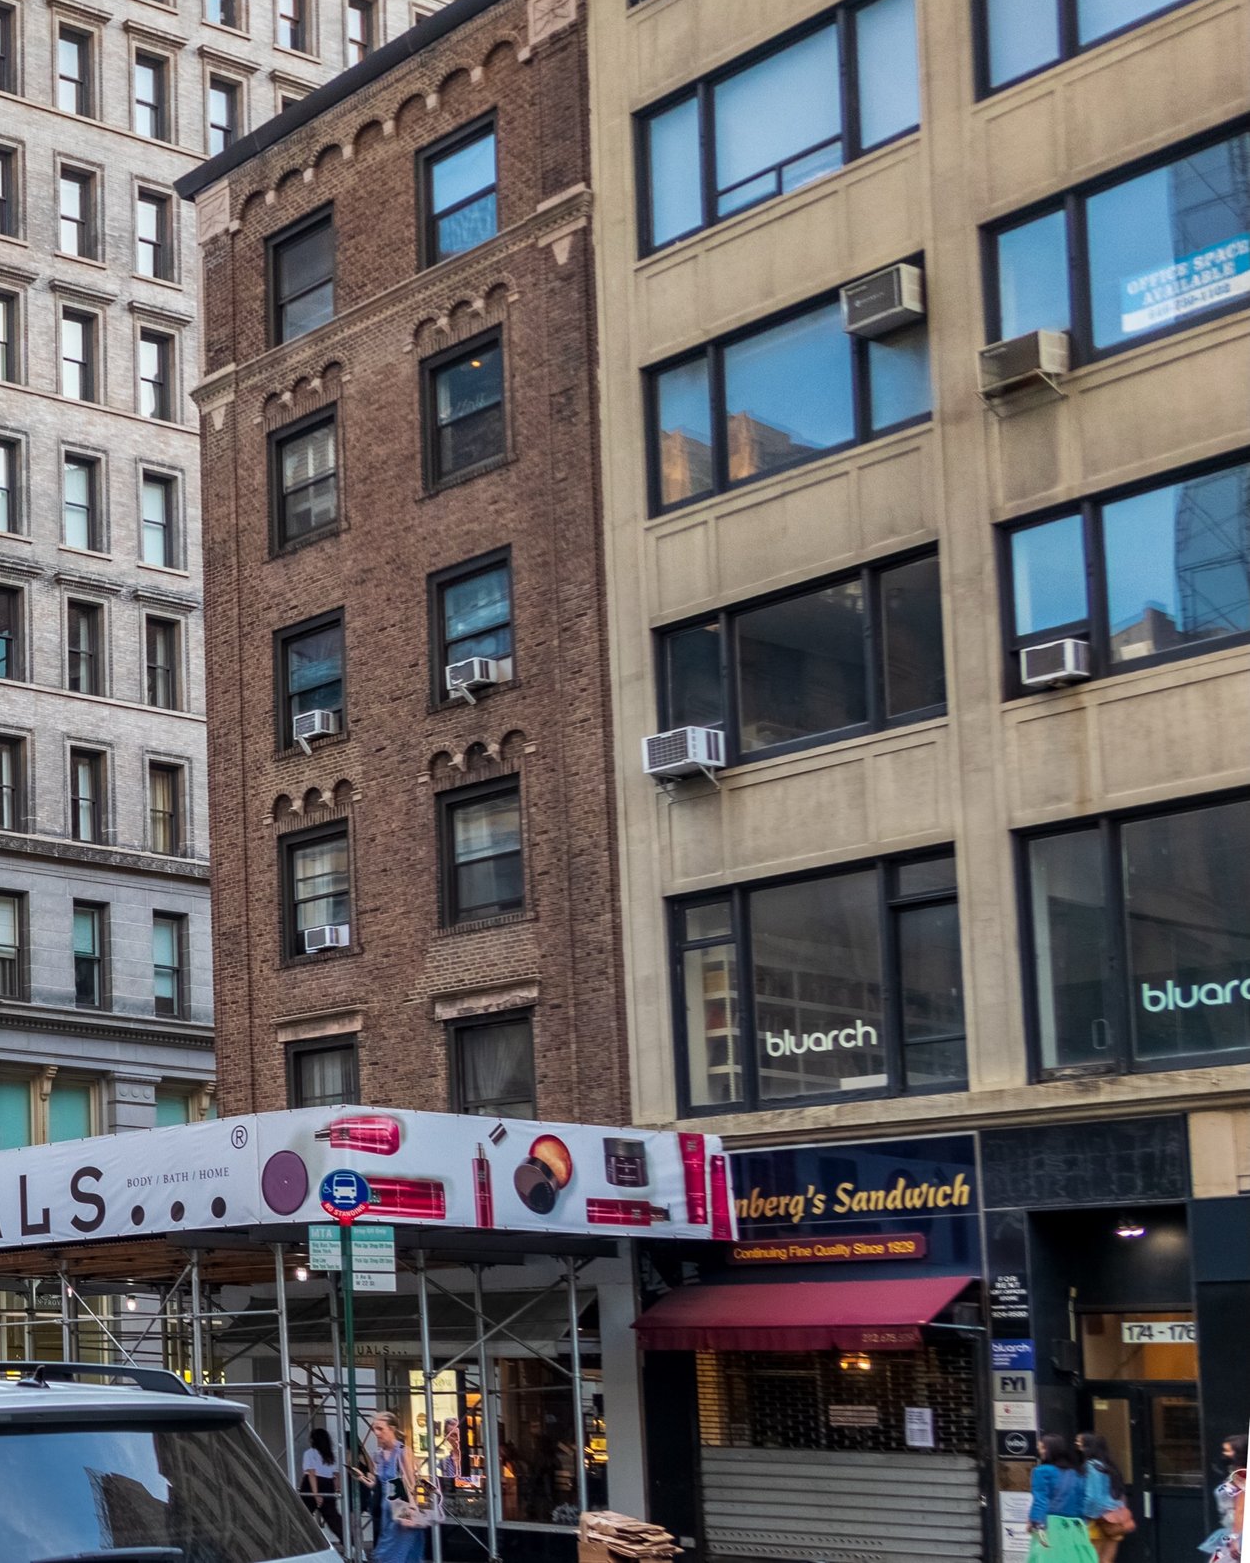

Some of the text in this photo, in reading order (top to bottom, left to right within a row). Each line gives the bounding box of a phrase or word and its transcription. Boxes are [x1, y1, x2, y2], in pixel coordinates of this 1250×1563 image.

[1193, 239, 1249, 270] SPACE
[1143, 262, 1236, 305] AVAILABLE
[1142, 978, 1250, 1012] bluarc
[766, 1020, 878, 1058] bluarch
[127, 1176, 153, 1188] BODY
[163, 1172, 189, 1184] BATH
[199, 1167, 230, 1180] HOME
[833, 1173, 971, 1214] Sandwich
[324, 1202, 366, 1217] NO STANDING
[312, 1228, 332, 1238] MTA
[734, 1241, 916, 1260] Continuing Fine Quality Since 1929
[1126, 1324, 1154, 1340] 174
[1168, 1324, 1196, 1340] 176
[991, 1342, 1031, 1352] bluarch
[1000, 1377, 1026, 1391] FYI
